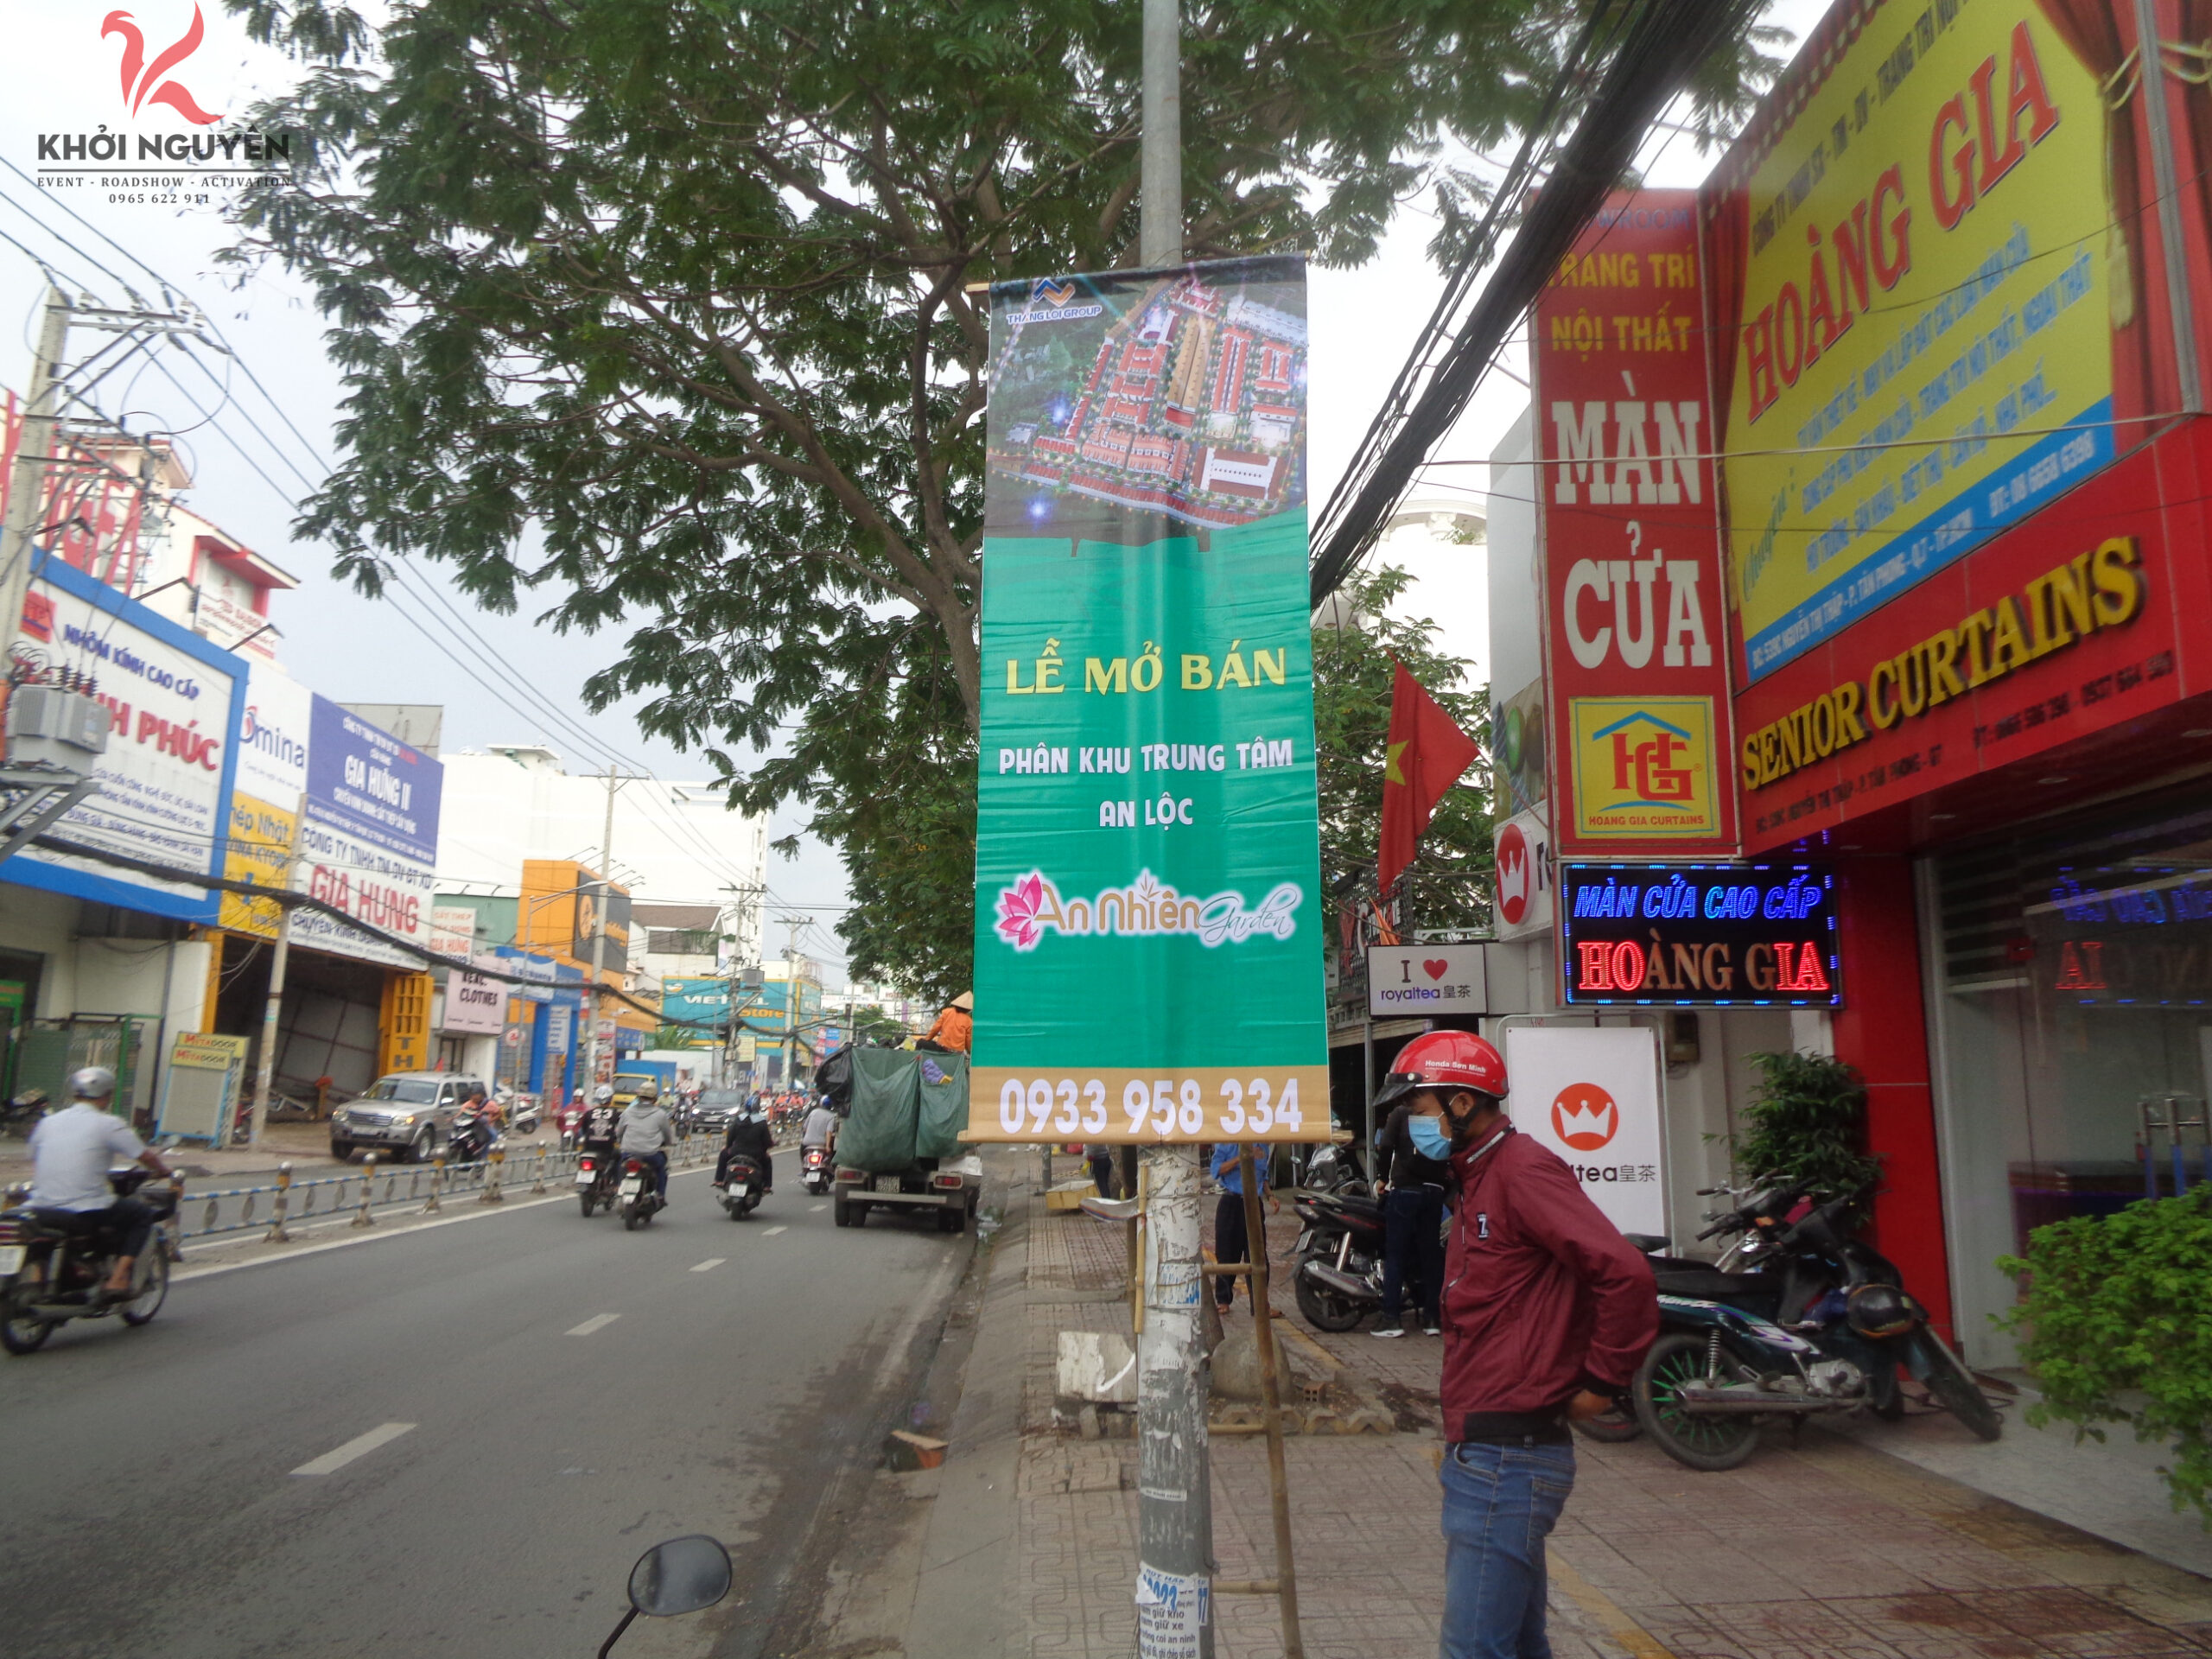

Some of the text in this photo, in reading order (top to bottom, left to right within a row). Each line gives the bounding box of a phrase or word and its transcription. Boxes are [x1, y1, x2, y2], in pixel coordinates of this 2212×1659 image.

[1585, 207, 1692, 231] WROOM
[1743, 19, 2060, 425] HOÀNG GIA
[1648, 244, 1694, 288] TRÍ
[1064, 305, 1103, 319] GROUP
[1551, 301, 1693, 363] NỘI THẤT
[1552, 370, 1701, 505] MÀN
[1564, 519, 1712, 669] CỬA
[113, 647, 144, 677] KÍNH
[148, 664, 173, 691] CAO
[175, 678, 200, 701] CẤP
[1007, 637, 1286, 696] LỄ MỞ BÁN
[1741, 535, 2145, 792] SENIOR CURTAINS
[137, 710, 220, 772] PHÚC
[999, 735, 1293, 775] PHÂN KHU TRUNG TÂM
[345, 753, 366, 791] GIA
[1099, 791, 1194, 831] AN LỘC
[1588, 812, 1705, 827] HOANG GIA CURTAINS
[303, 826, 332, 855] CÔNG
[335, 840, 349, 861] TY
[309, 863, 350, 914] GIA
[1573, 872, 1822, 919] MÀN CỬA CAO CẤP
[1037, 883, 1089, 931] An
[1098, 885, 1199, 931] Nhiên
[1198, 887, 1298, 943] Garden
[1401, 959, 1411, 982] I
[1577, 927, 1831, 991] HOÀNG GIA
[460, 988, 499, 1007] CLOTHES
[1381, 987, 1440, 1002] royaltea
[1425, 1059, 1450, 1068] Honda
[1468, 1064, 1486, 1074] Minh
[590, 1107, 613, 1121] 23
[1000, 1078, 1303, 1135] 0933 958 334
[1172, 1622, 1184, 1631] xe
